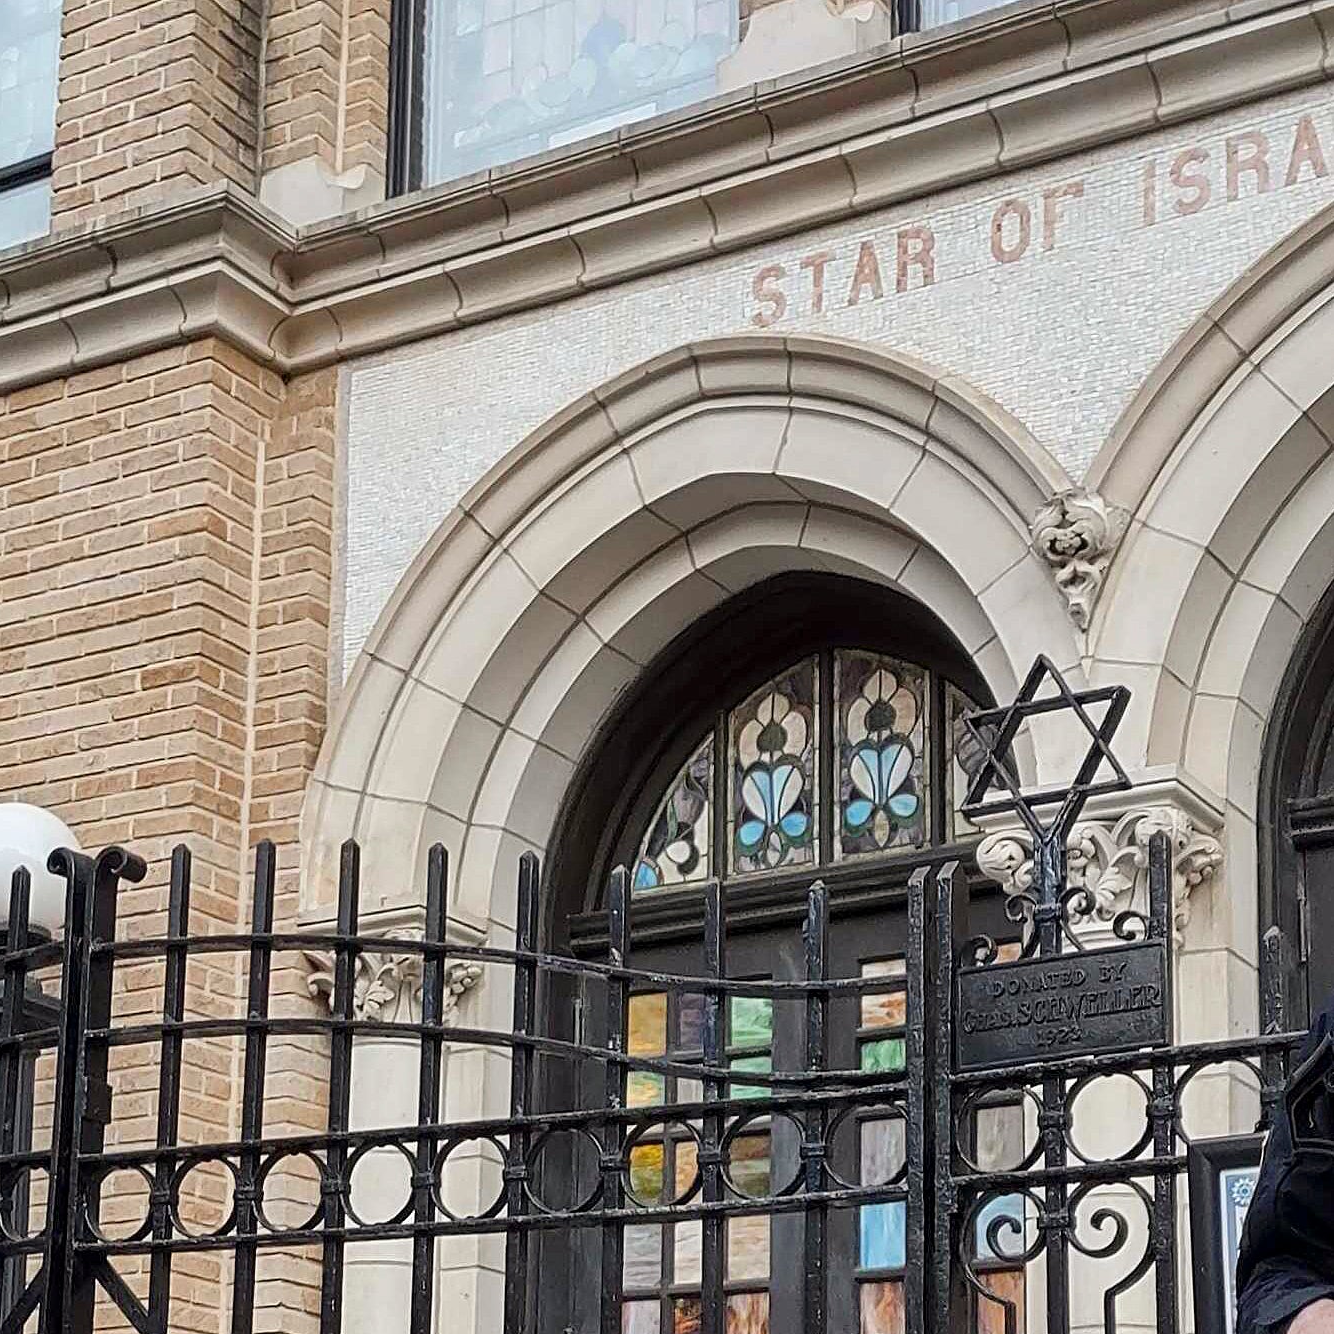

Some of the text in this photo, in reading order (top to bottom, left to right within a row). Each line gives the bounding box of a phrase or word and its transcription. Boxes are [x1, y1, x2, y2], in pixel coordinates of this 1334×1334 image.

[751, 226, 936, 327] STAR
[990, 180, 1083, 264] OF
[994, 962, 1128, 998] DONATED BY
